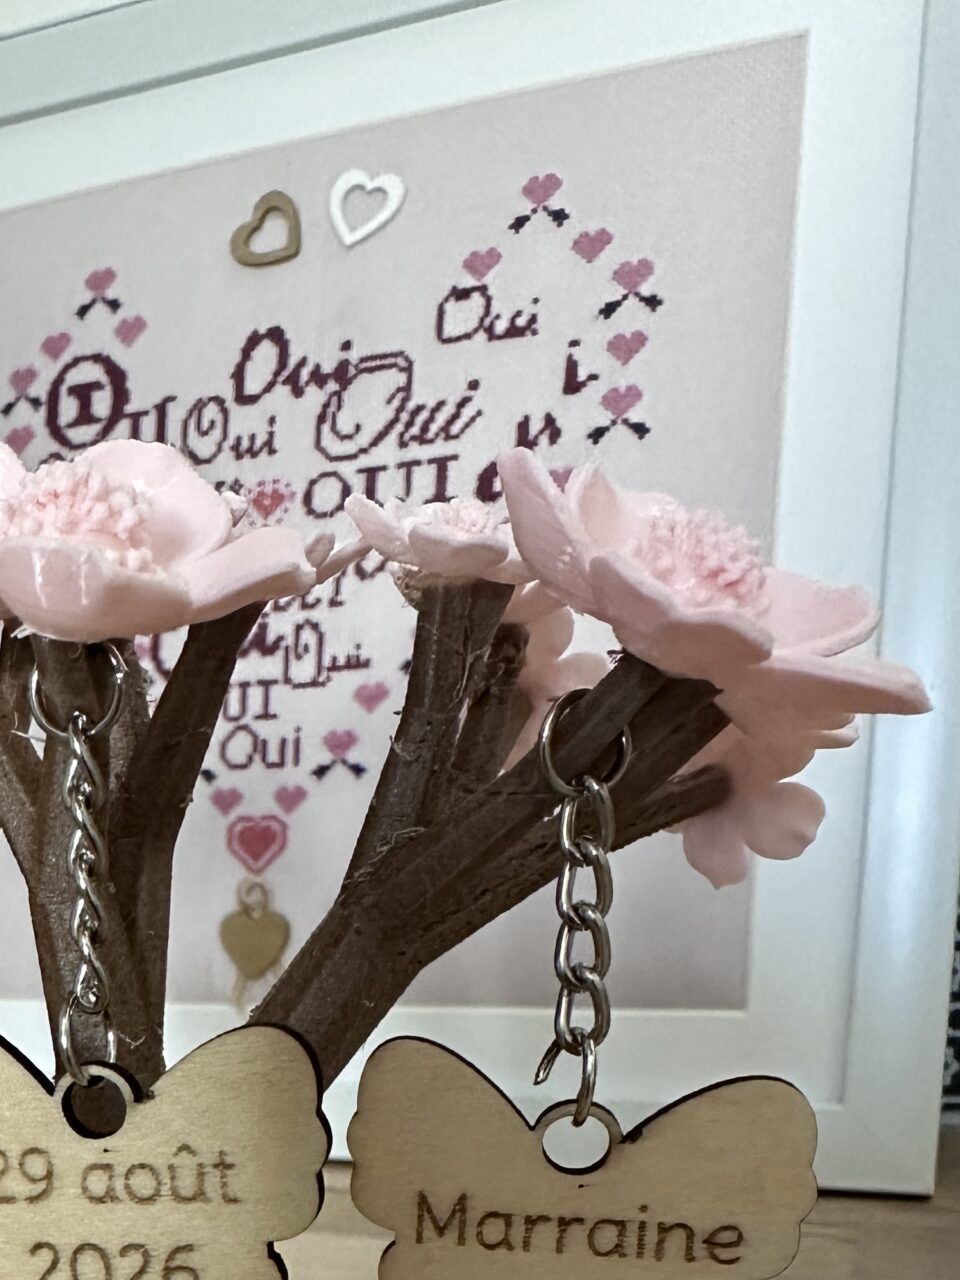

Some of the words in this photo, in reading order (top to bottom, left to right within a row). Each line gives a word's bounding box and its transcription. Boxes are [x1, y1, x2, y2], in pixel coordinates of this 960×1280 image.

[436, 284, 540, 344] Oui
[230, 326, 356, 406] Oui
[182, 395, 278, 465] Oui
[315, 351, 483, 463] Oui
[303, 455, 459, 519] OUI
[223, 679, 279, 722] UI
[220, 724, 301, 769] Oui
[80, 1143, 241, 1205] août
[414, 1189, 745, 1266] Marraine
